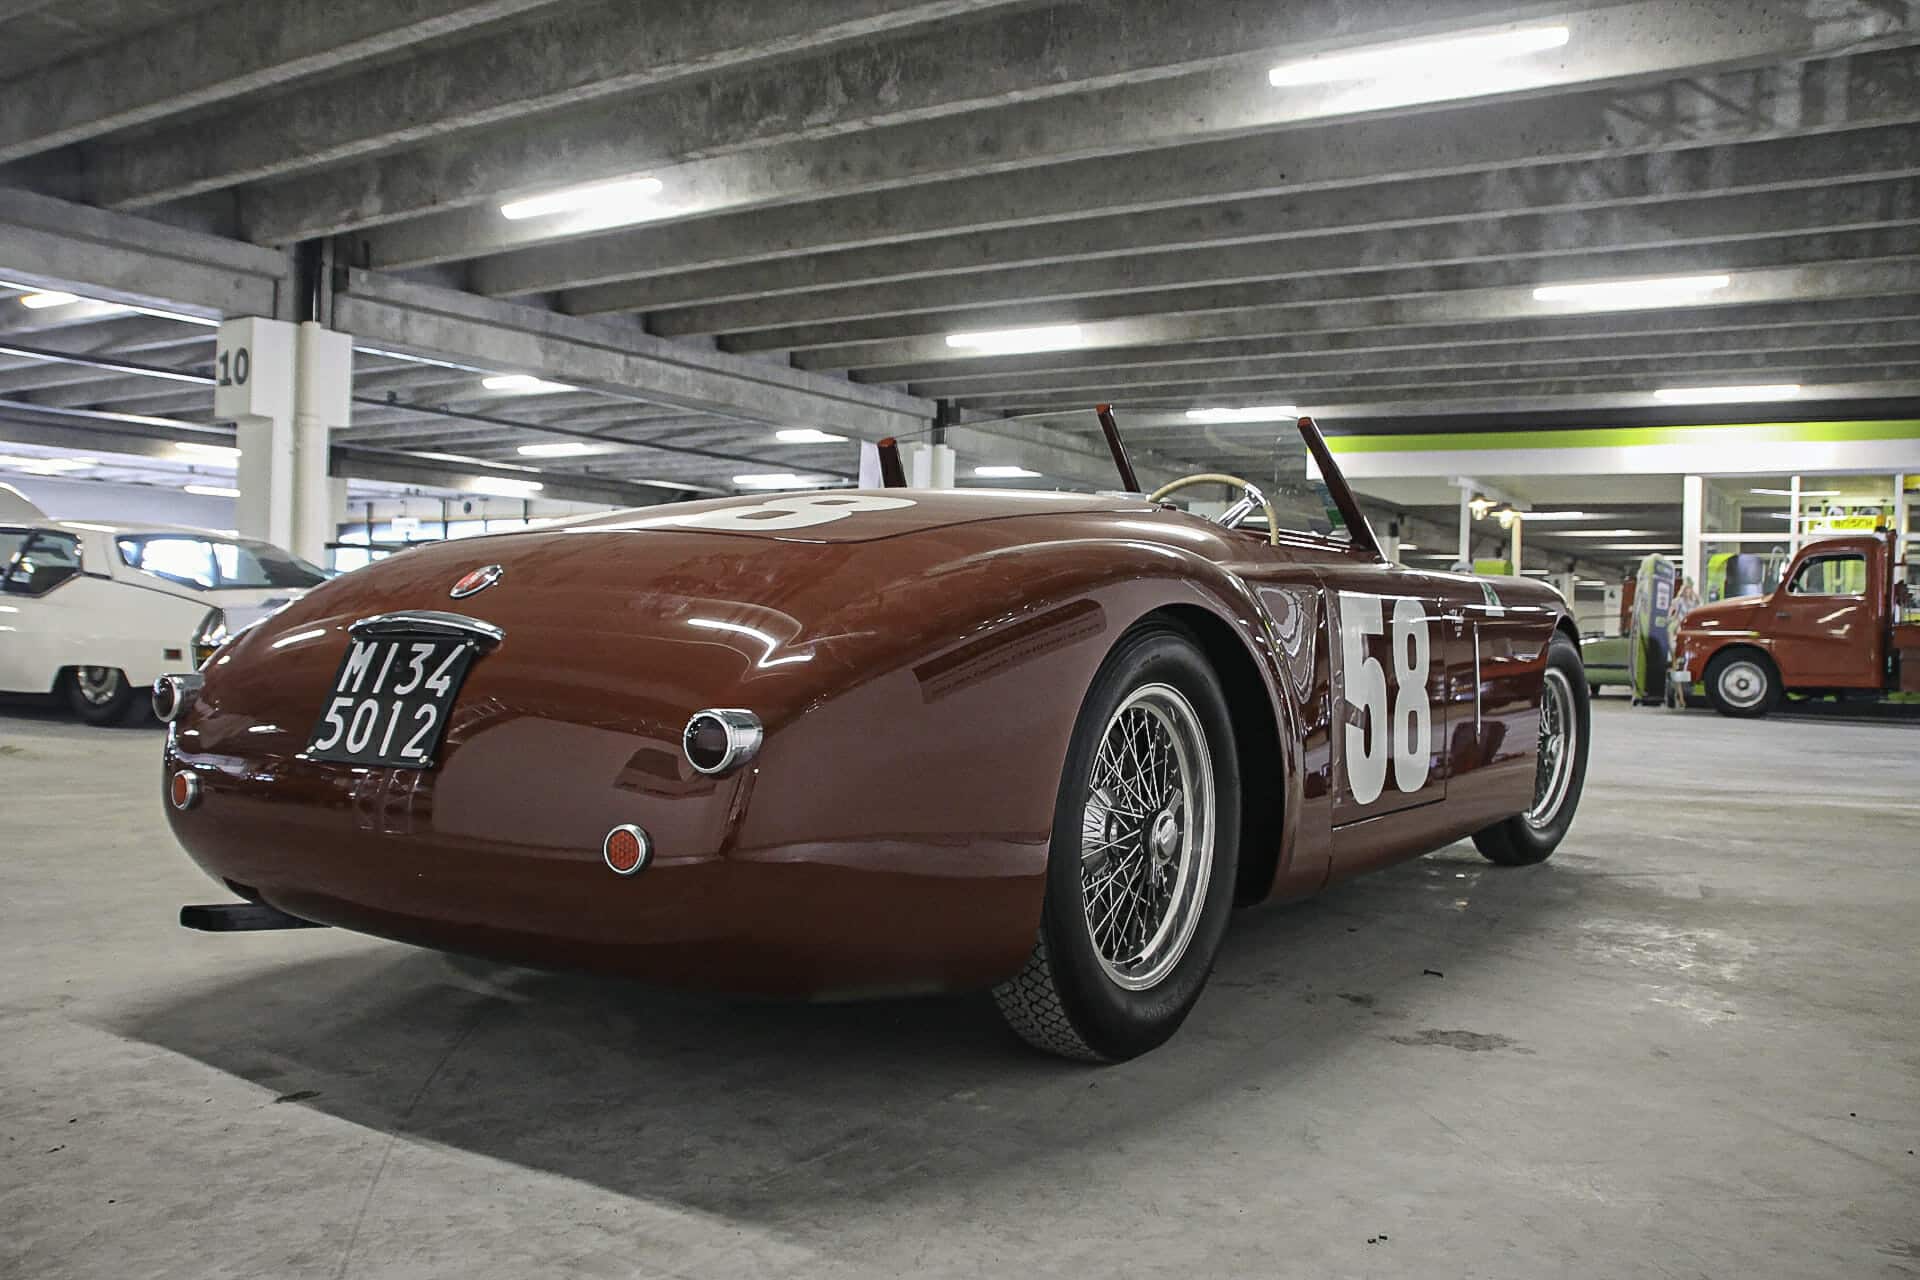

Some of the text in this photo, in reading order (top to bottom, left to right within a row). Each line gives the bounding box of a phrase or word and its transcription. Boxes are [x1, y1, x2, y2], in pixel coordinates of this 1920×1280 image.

[218, 347, 250, 386] 10
[315, 697, 438, 758] 5012
[1338, 590, 1432, 805] 58
